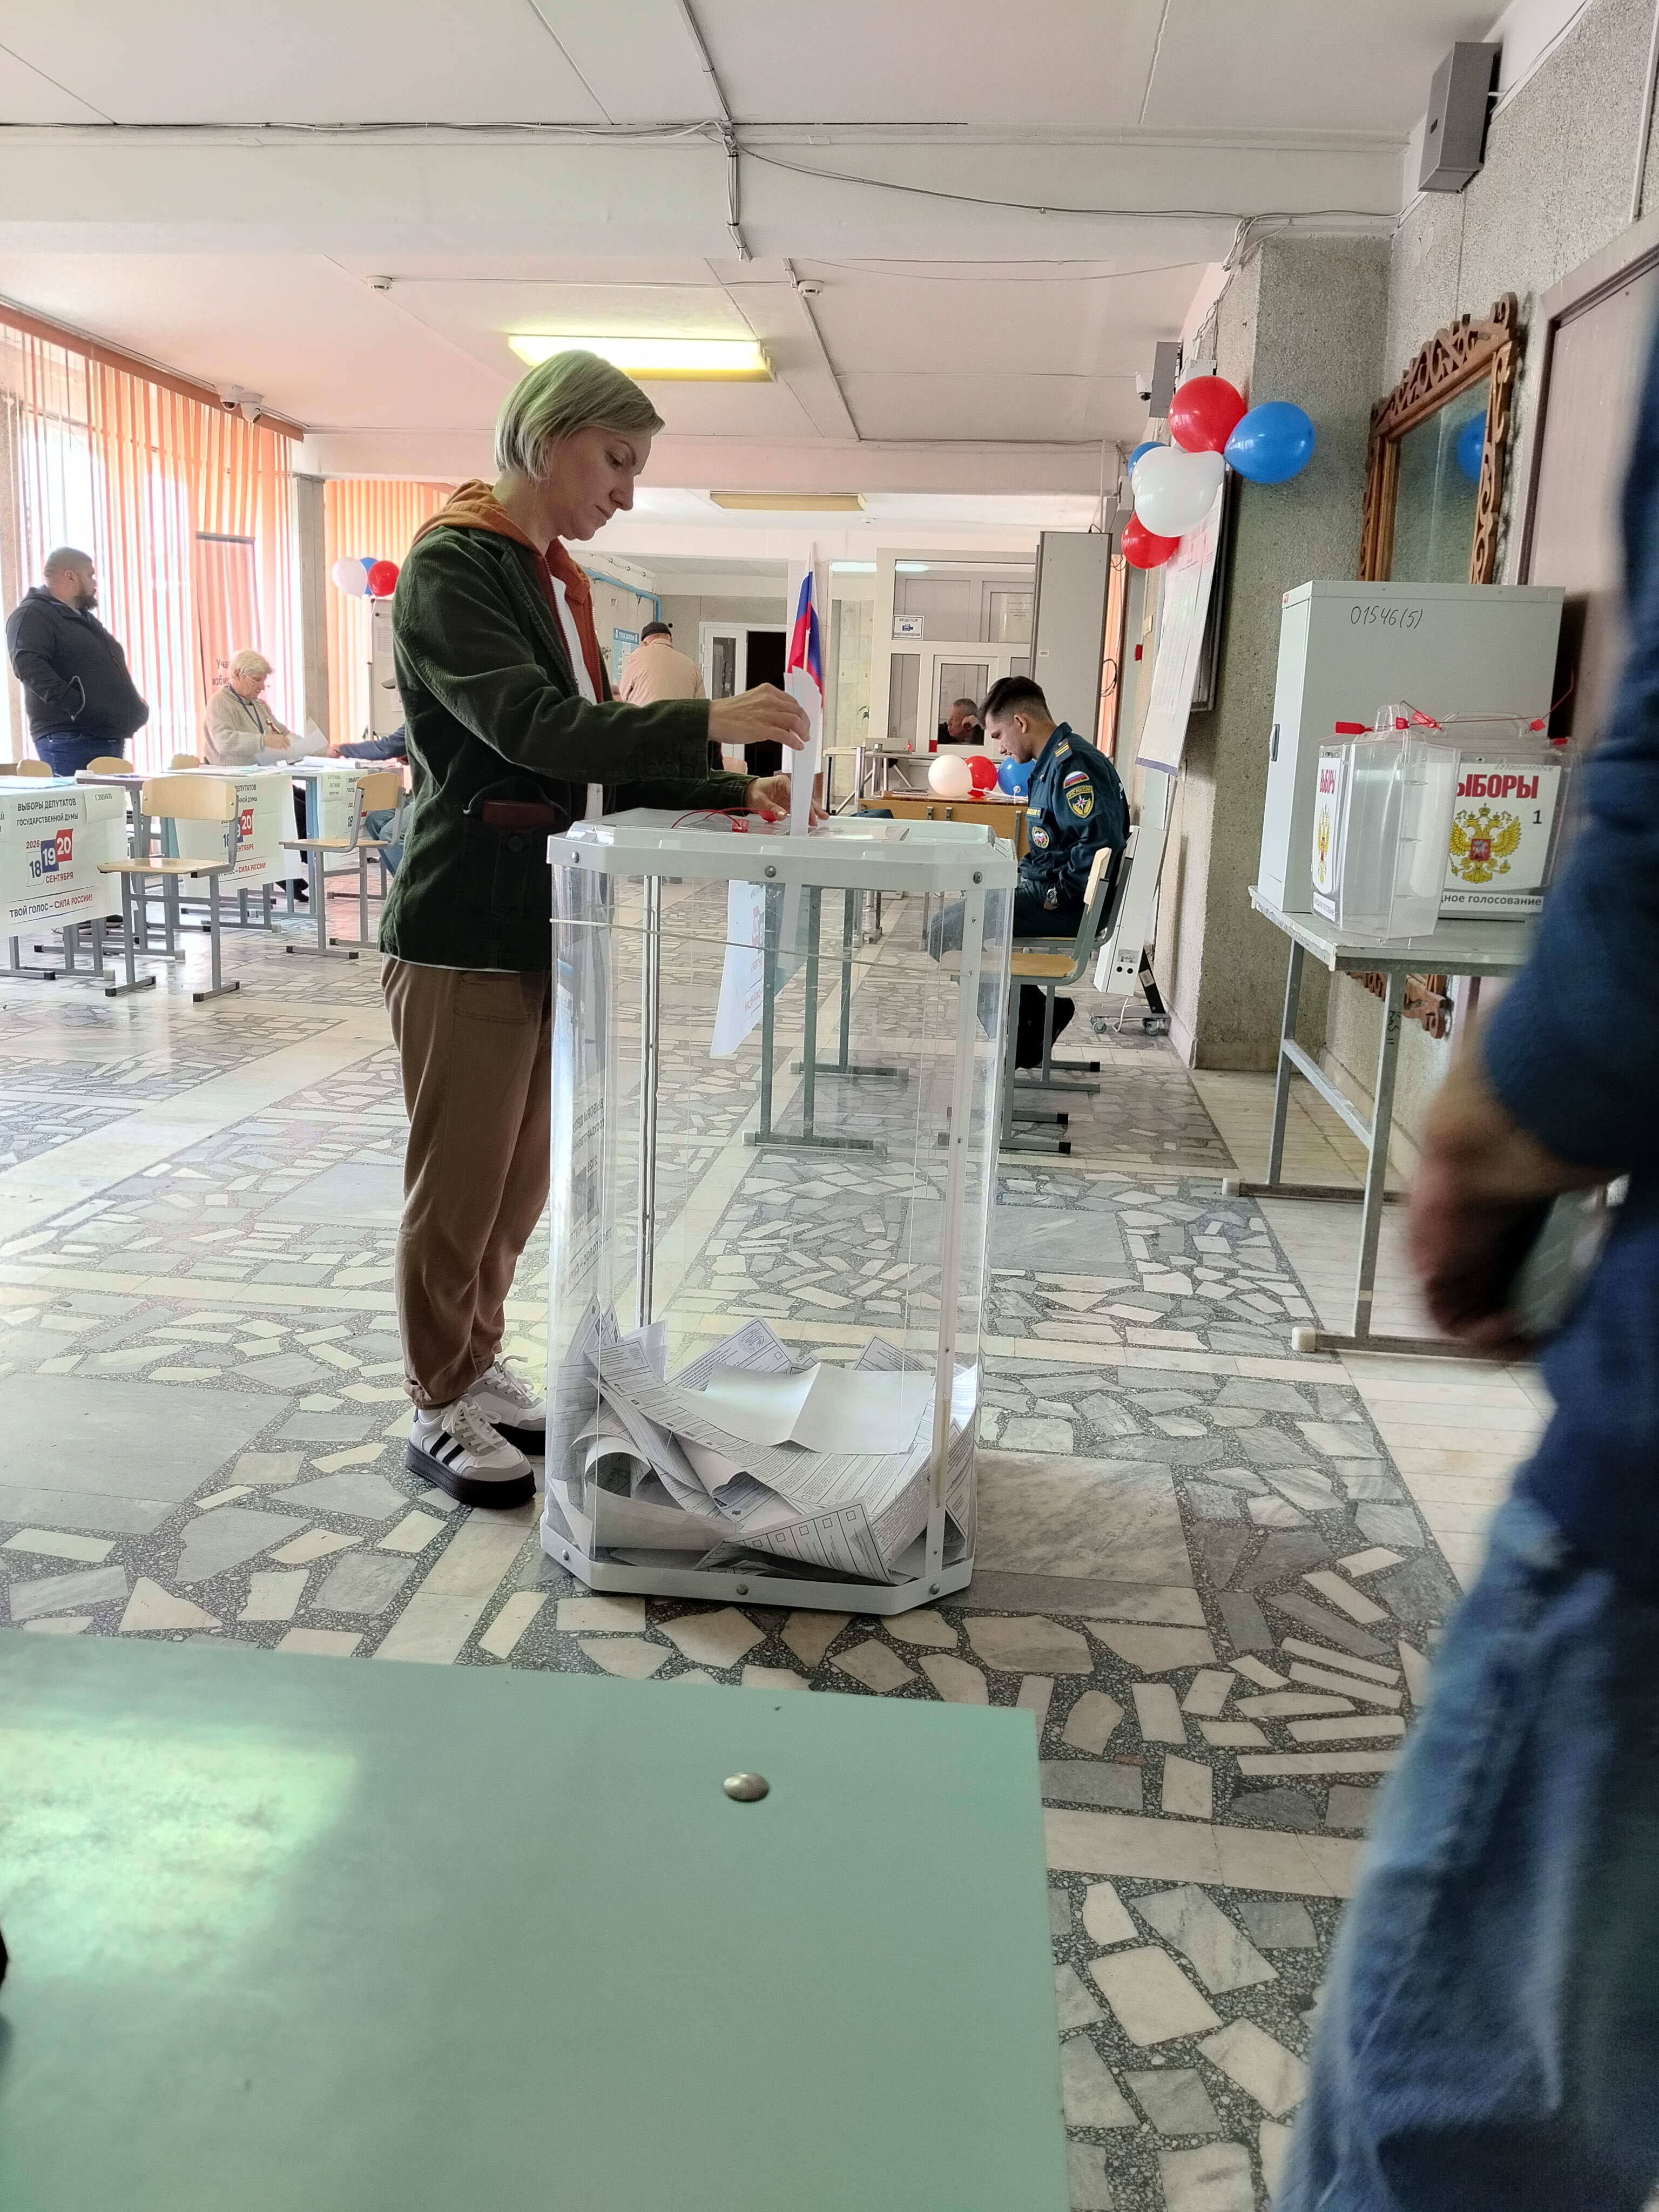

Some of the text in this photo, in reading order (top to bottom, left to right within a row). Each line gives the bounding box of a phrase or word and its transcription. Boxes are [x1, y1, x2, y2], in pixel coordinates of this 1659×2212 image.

[1351, 606, 1423, 629] 01546(5)
[1456, 774, 1539, 799] ЫБОРЫ
[95, 793, 113, 801] ГЛИНКИ
[17, 798, 77, 812] ВЫБОРЫ ДЕПУТАТОВ
[17, 813, 64, 827] ГОСУДАРСТВЕННОЙ
[64, 813, 78, 821] ДУМЫ
[241, 815, 252, 830] 20
[1533, 810, 1542, 824] 1
[26, 840, 40, 849] 2026
[237, 844, 254, 852] ЕНТЯБРЯ
[29, 837, 71, 879] 18 19 20
[238, 864, 250, 873] СИЛА
[45, 872, 74, 884] СЕНТЯБРЯ
[9, 905, 28, 918] ТВОЙ
[29, 902, 49, 914] ГОЛОС
[54, 899, 70, 909] СИЛА
[71, 893, 93, 906] РОССИИ!
[1468, 895, 1542, 906] голосование
